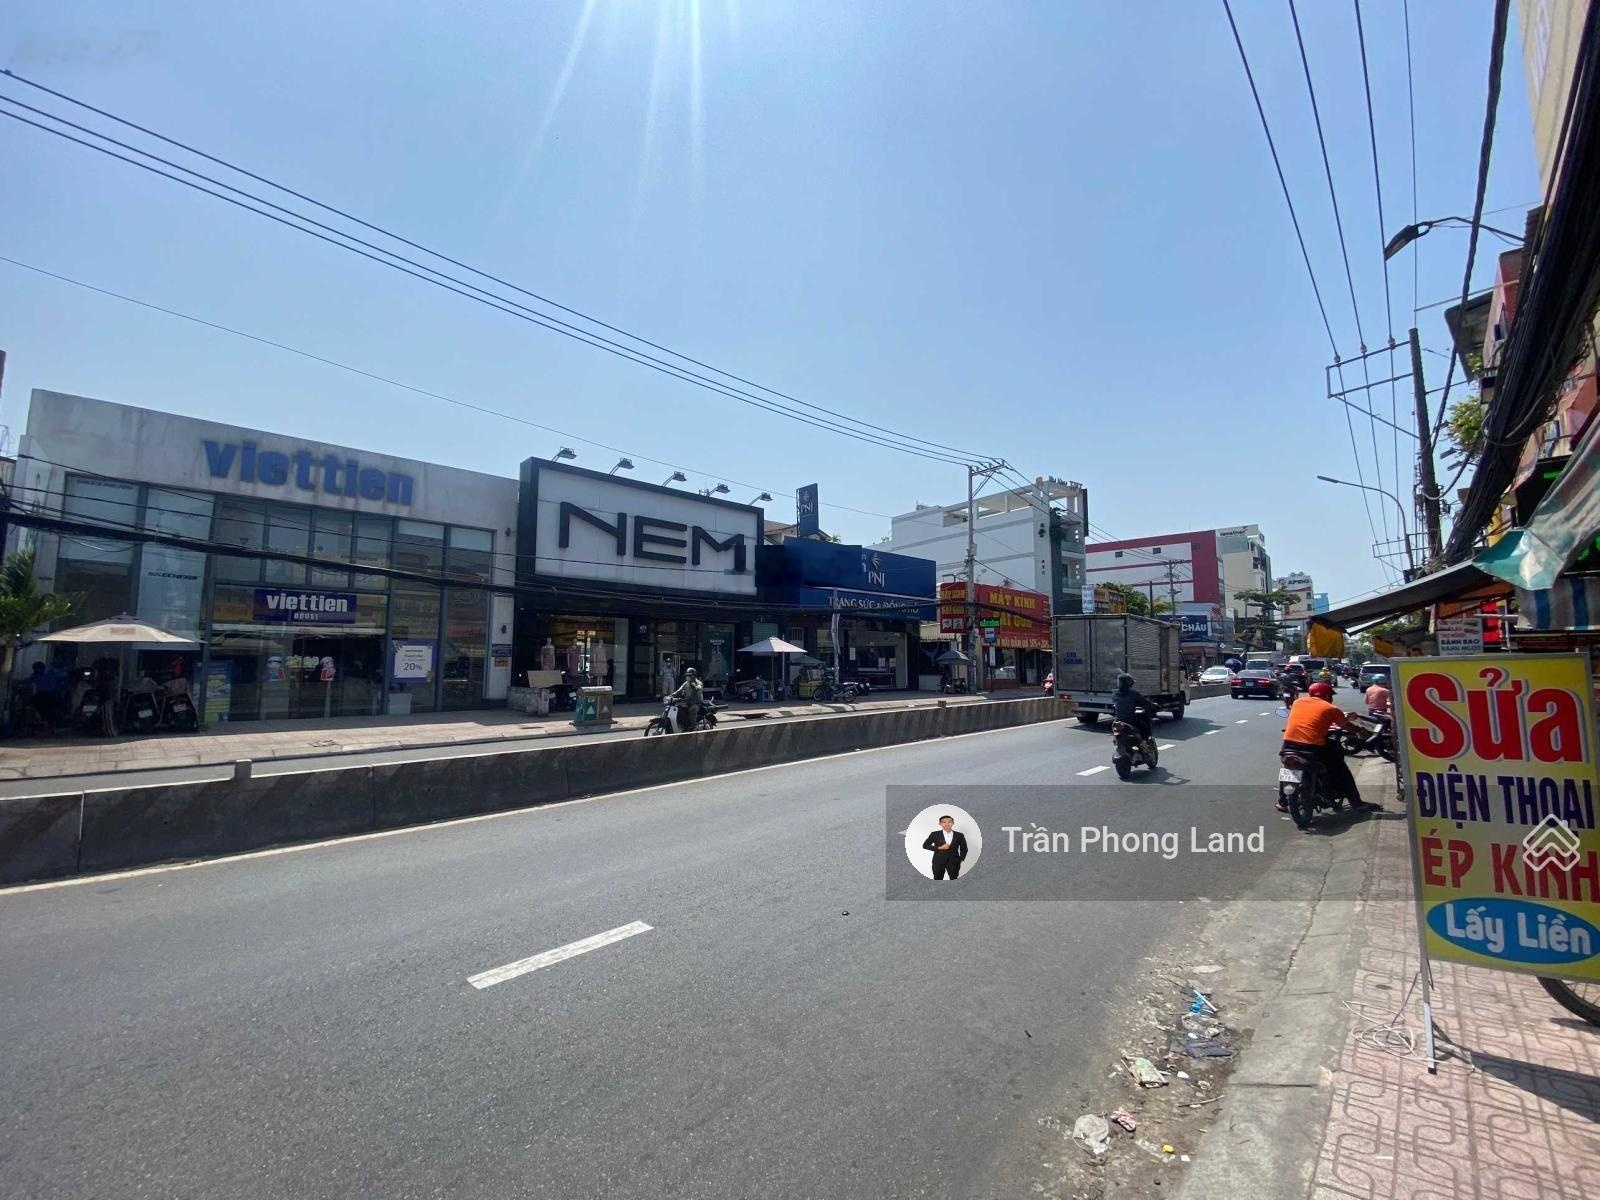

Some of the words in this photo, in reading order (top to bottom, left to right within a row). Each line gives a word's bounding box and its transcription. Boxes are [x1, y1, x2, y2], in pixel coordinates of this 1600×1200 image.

[204, 441, 413, 506] viettien
[558, 501, 746, 572] NEM
[800, 502, 813, 514] PNJ
[266, 592, 348, 612] viettien
[868, 571, 885, 588] PNJ
[1181, 621, 1207, 632] CHÂU
[1407, 667, 1588, 764] Sửa
[1416, 764, 1491, 829] ĐIỆN
[1497, 775, 1596, 838] THOẠI
[1420, 829, 1474, 889] ÉP
[1491, 836, 1600, 904] KÍNH
[1445, 903, 1505, 953] Lấy
[1517, 911, 1592, 955] Liền
